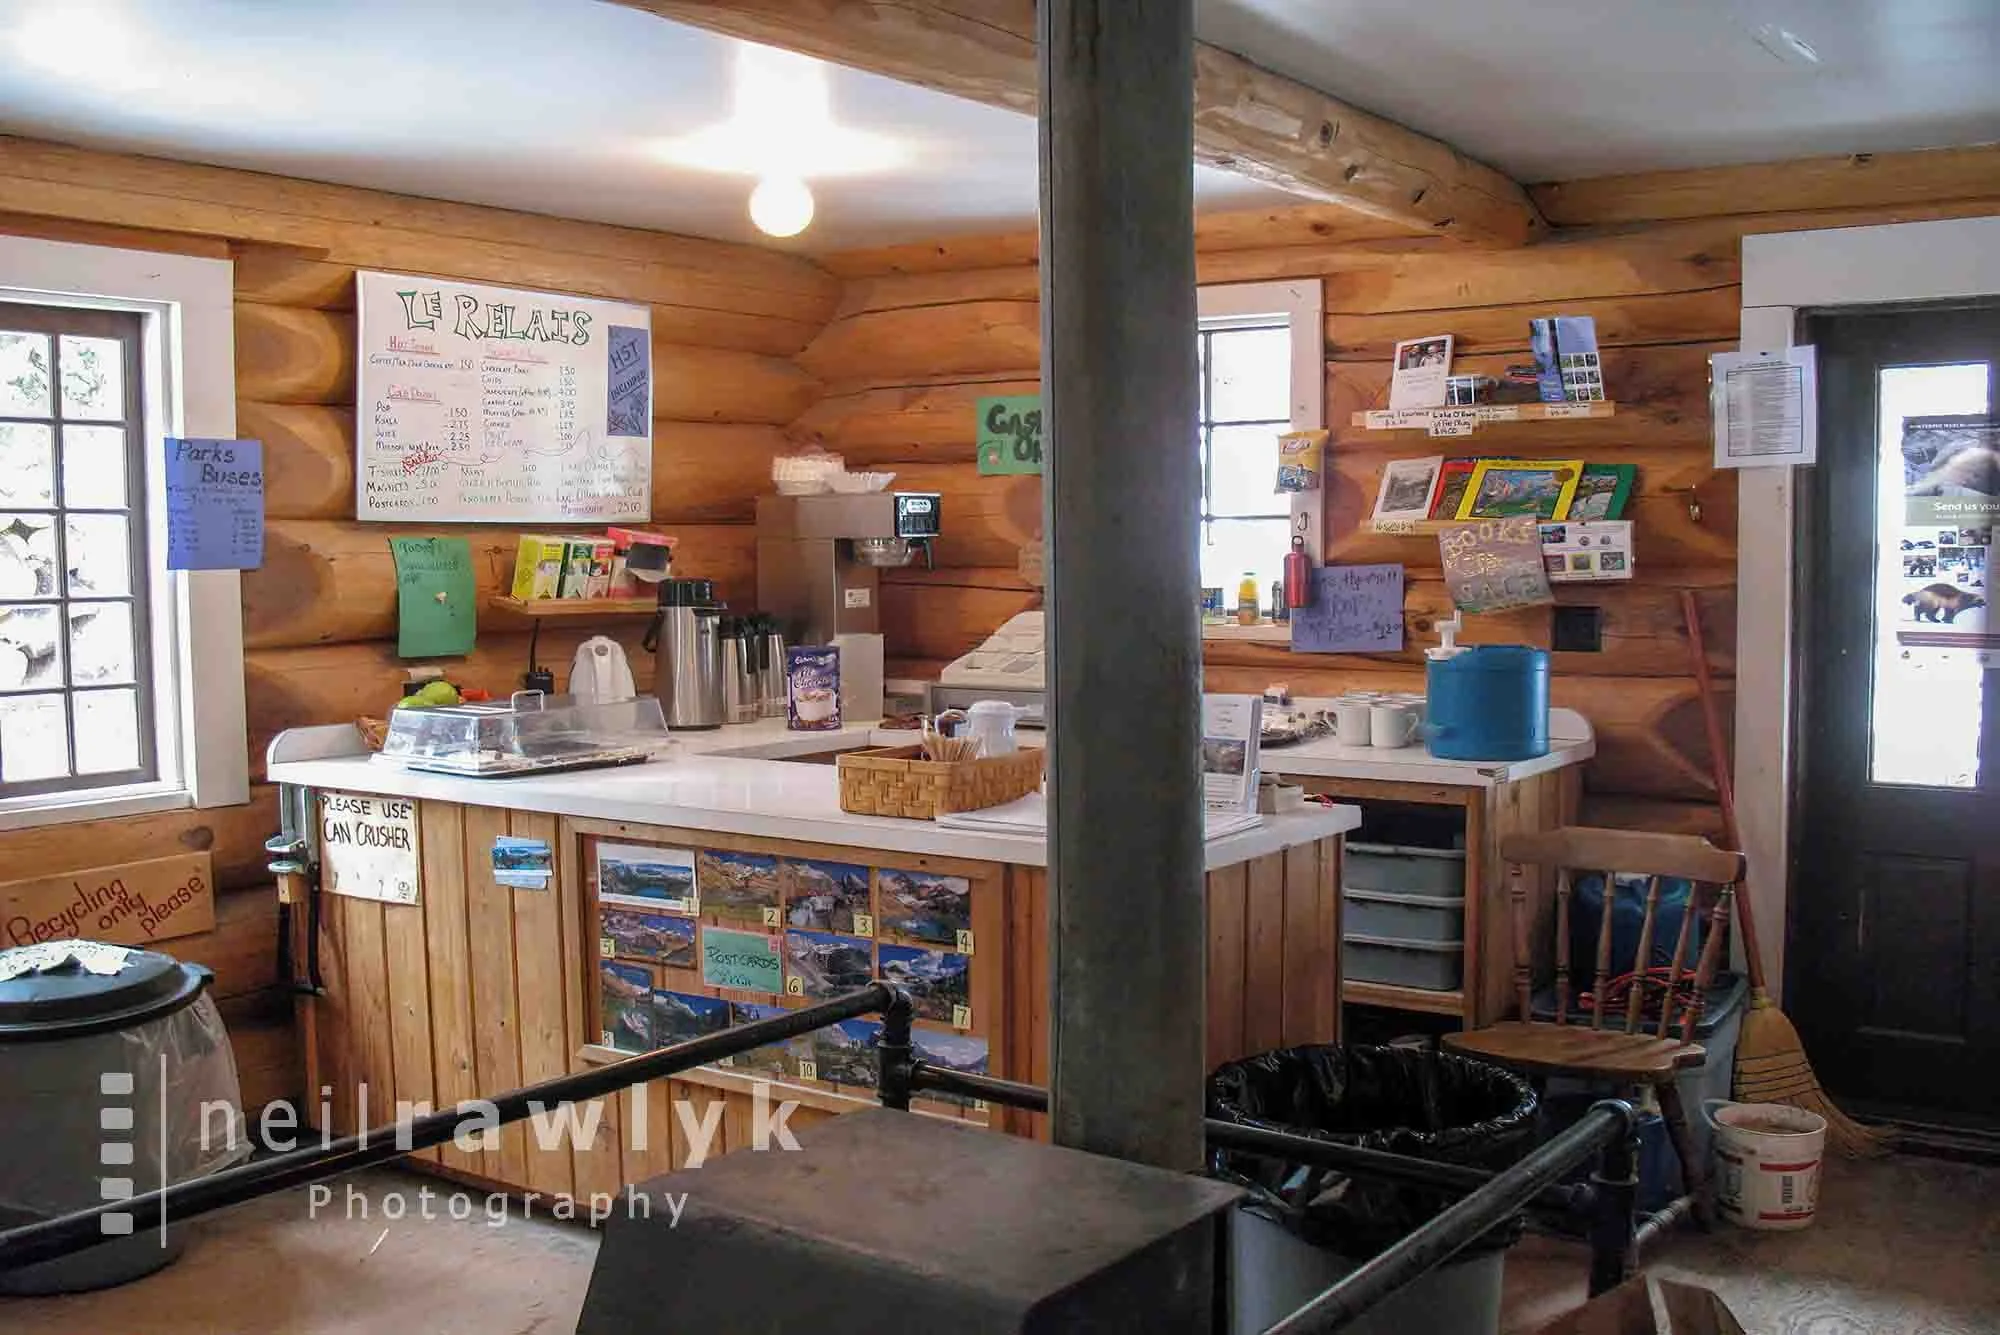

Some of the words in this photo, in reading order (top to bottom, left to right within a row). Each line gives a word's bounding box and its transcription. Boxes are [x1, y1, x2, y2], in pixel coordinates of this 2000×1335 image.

[396, 291, 442, 331] LE
[453, 294, 593, 346] RELAIS
[175, 440, 235, 463] Parks
[202, 463, 262, 486] Buses
[1934, 502, 1961, 511] Send
[1964, 503, 1977, 511] us
[320, 794, 372, 815] PLEASE
[382, 801, 412, 819] USE
[324, 817, 352, 844] CAN
[356, 821, 411, 852] CRUSHER
[6, 878, 129, 944] Recycling
[98, 893, 147, 931] only
[141, 876, 205, 936] please
[767, 911, 776, 922] 2
[859, 918, 868, 932] 3
[960, 932, 971, 952] 4
[788, 978, 798, 993] 6
[956, 1008, 967, 1021] 7
[803, 1063, 813, 1077] 10
